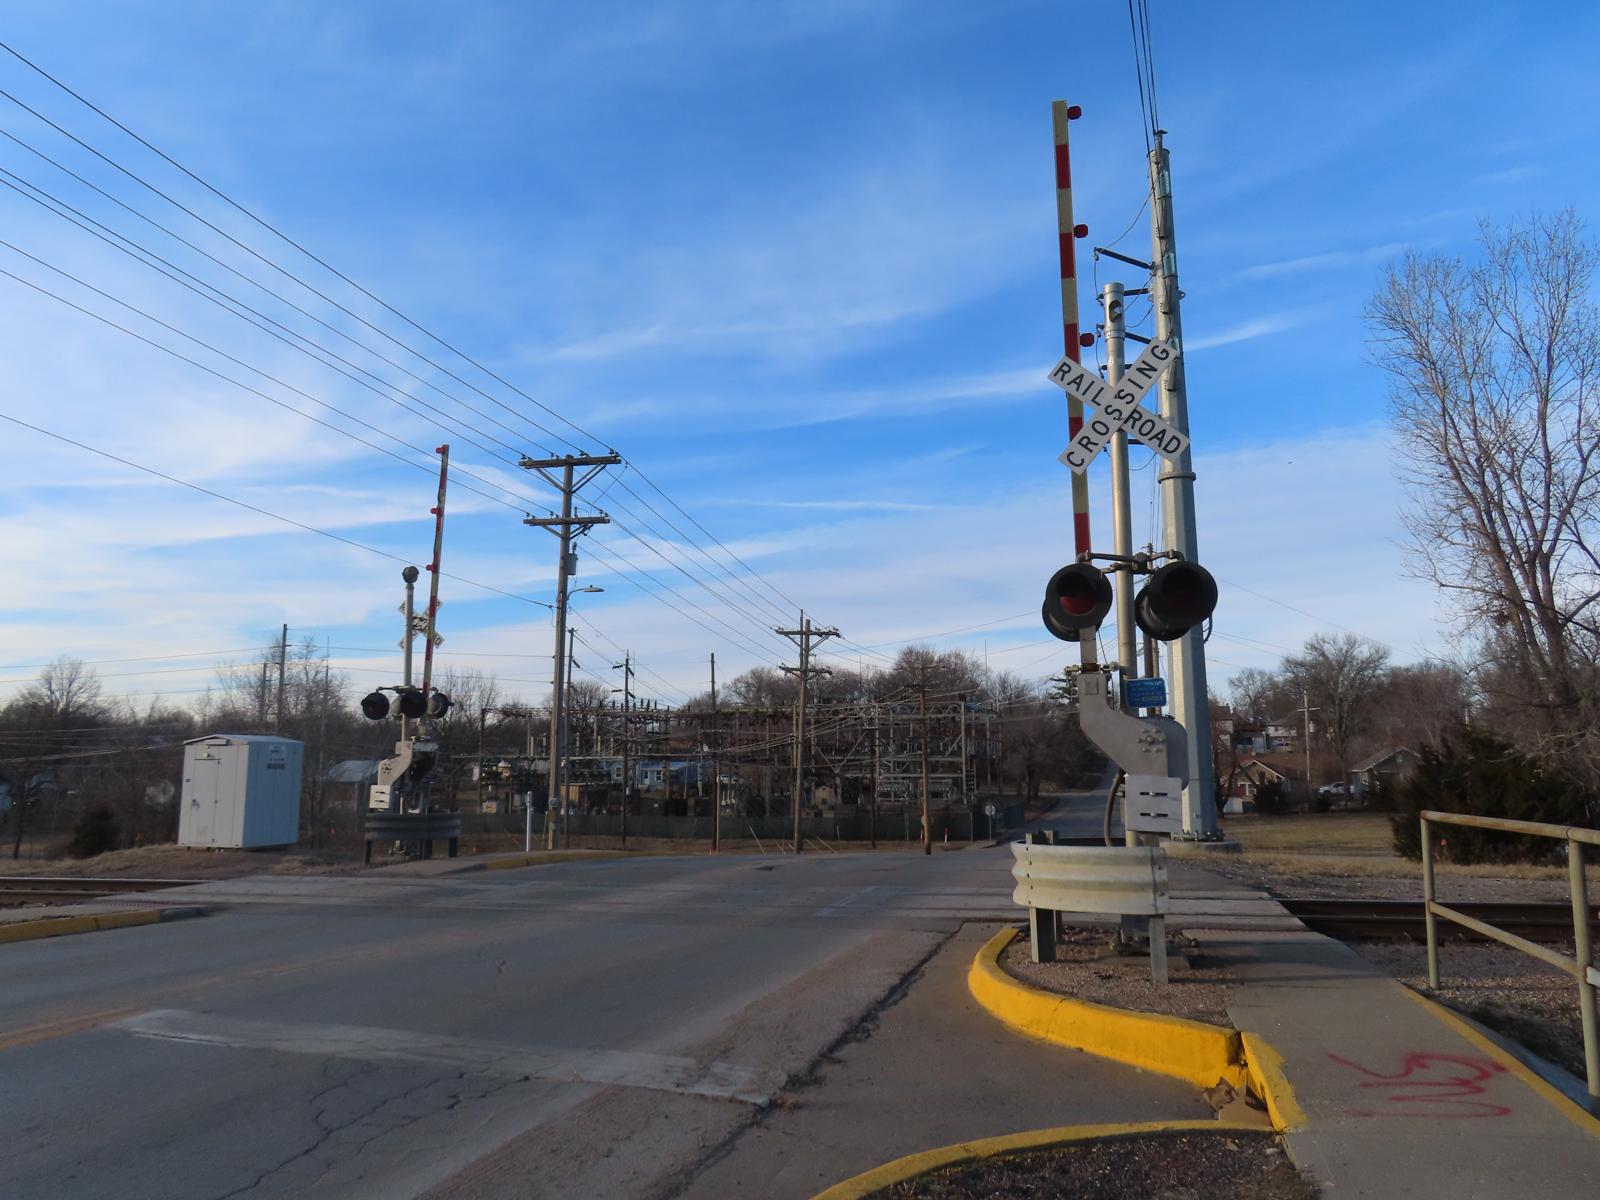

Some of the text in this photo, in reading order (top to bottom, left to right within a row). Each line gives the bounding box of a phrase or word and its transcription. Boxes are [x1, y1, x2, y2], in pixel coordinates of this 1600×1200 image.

[1053, 361, 1181, 454] RAIL ROAD
[1066, 344, 1170, 467] CROSSING
